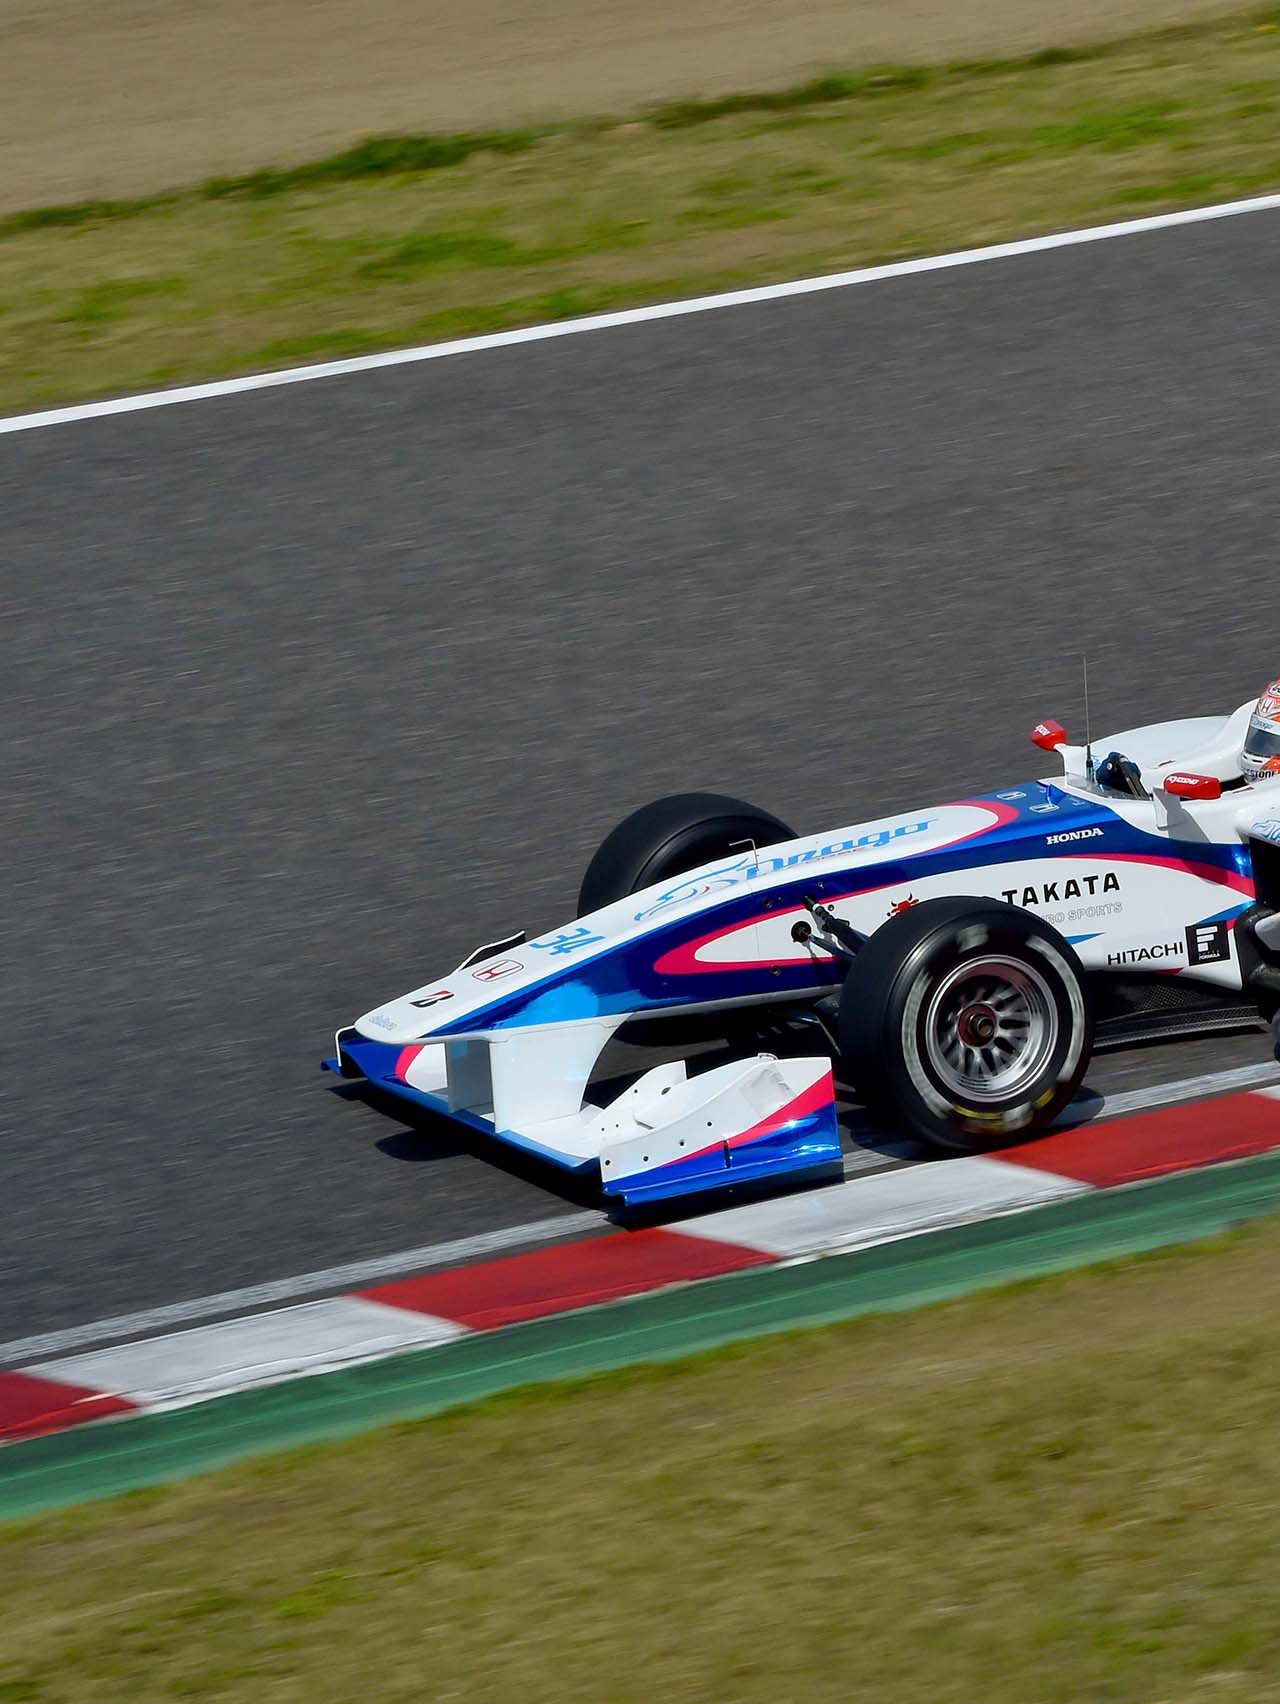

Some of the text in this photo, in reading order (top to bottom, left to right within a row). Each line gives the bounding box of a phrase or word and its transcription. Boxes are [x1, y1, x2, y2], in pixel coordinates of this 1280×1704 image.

[1046, 828, 1104, 845] HONDA
[1001, 872, 1121, 907] TAKATA
[1067, 902, 1123, 921] SPORTS
[529, 928, 606, 956] 34
[1107, 941, 1184, 966] HITACHI
